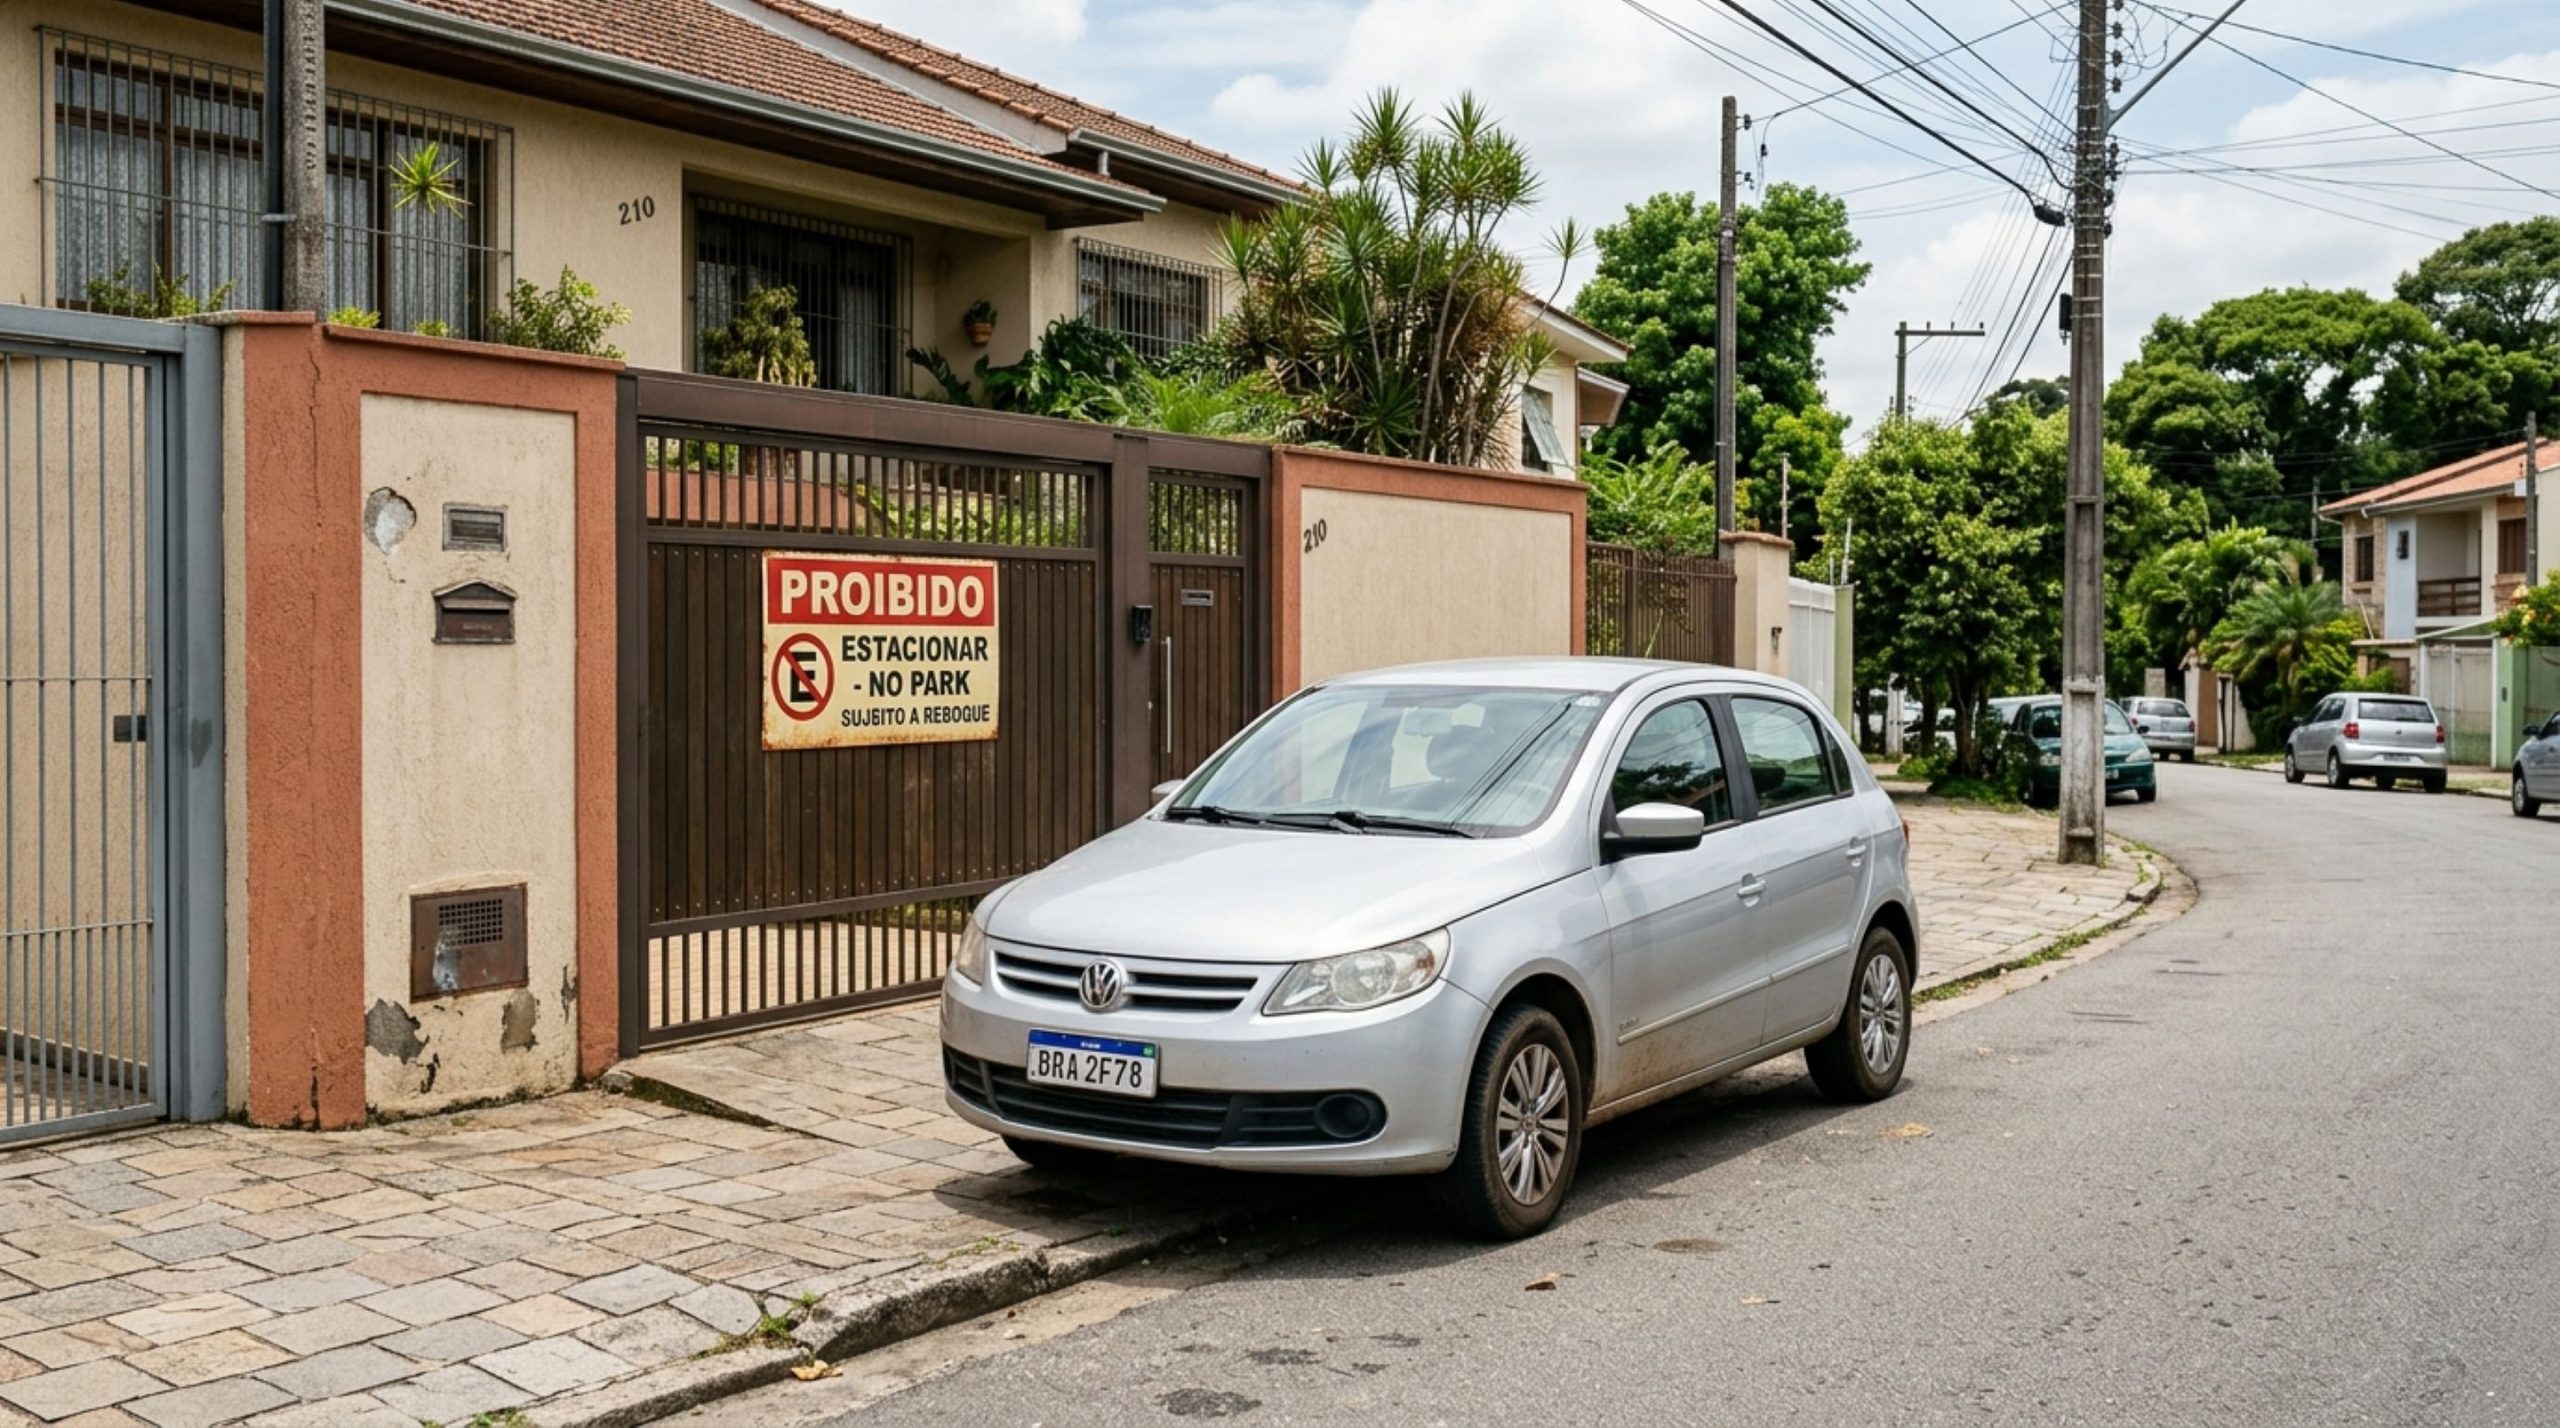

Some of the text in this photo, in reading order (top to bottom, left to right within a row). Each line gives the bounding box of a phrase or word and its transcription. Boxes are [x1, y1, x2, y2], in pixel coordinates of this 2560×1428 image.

[618, 195, 655, 226] 210
[1303, 518, 1328, 553] 210
[780, 569, 985, 618] PROIBIDO
[841, 634, 989, 662] ESTACIONAR
[869, 670, 903, 697] NO
[910, 669, 971, 697] PARK
[909, 707, 920, 724] A
[1038, 1049, 1143, 1089] BRA 2F78
